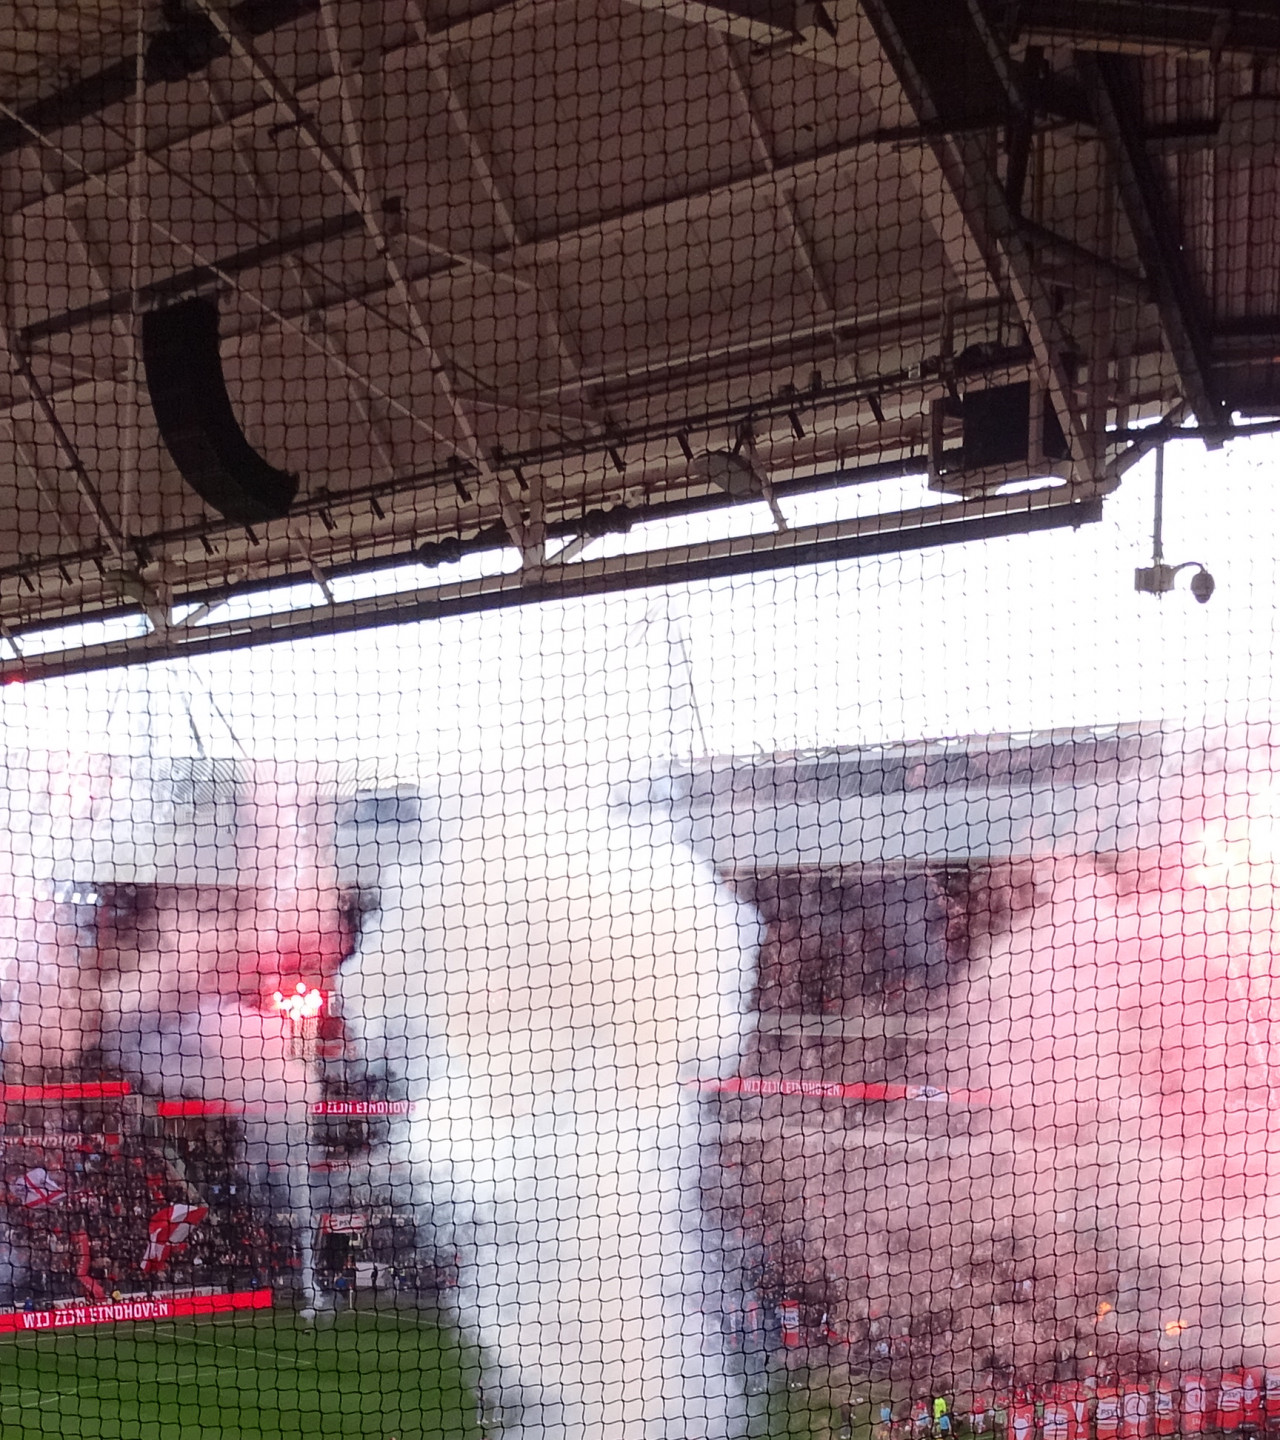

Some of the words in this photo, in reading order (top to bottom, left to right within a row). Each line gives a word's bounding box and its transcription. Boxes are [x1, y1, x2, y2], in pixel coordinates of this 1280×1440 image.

[326, 1101, 353, 1114] ZIJN
[23, 1313, 49, 1328] WIJ
[55, 1308, 86, 1326] ZIJN
[90, 1303, 168, 1323] EINDHOVEN
